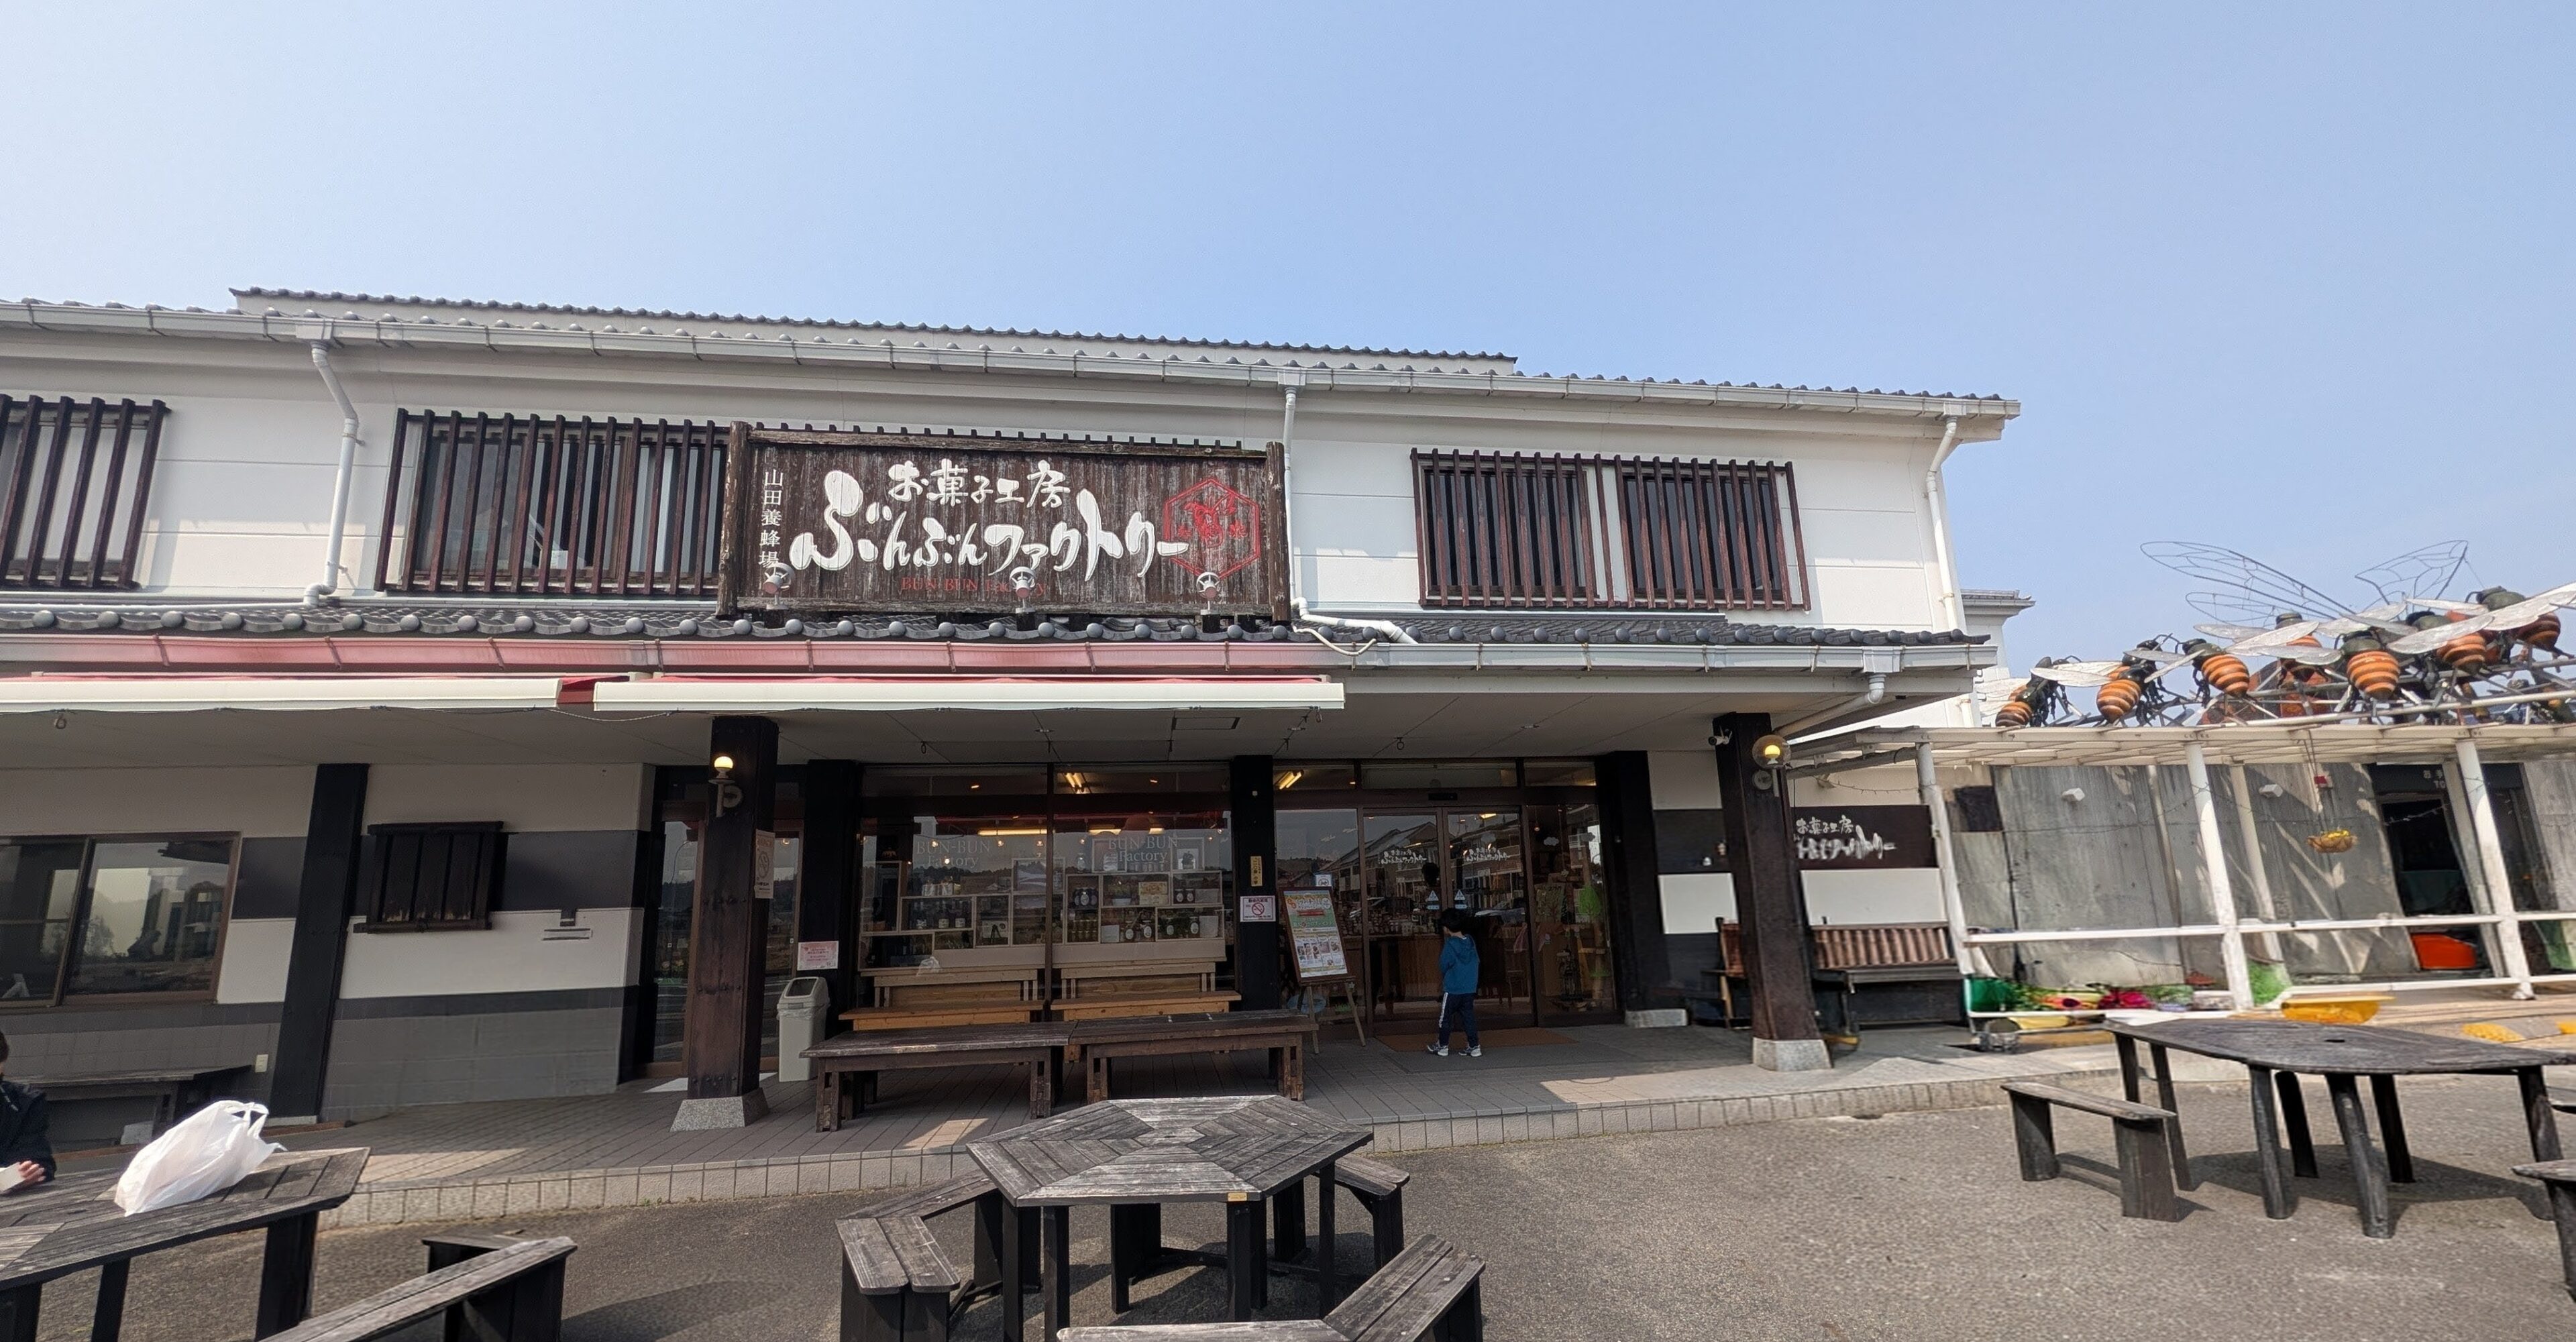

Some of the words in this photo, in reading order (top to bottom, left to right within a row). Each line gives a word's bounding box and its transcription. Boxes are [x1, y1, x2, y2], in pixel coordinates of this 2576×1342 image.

[888, 459, 1070, 510] お菓子工房
[759, 469, 783, 567] 山田養蜂場
[789, 469, 1189, 581] ぶんぶんファクトリー
[900, 577, 937, 591] BUN
[944, 578, 979, 592] BUN
[985, 579, 1045, 596] Facy
[1796, 814, 1854, 834] お菓子工房
[916, 840, 991, 854] BUN-BUN
[1108, 835, 1179, 850] BUN-BUN
[927, 856, 979, 869] Fatory
[1119, 850, 1169, 863] Factory
